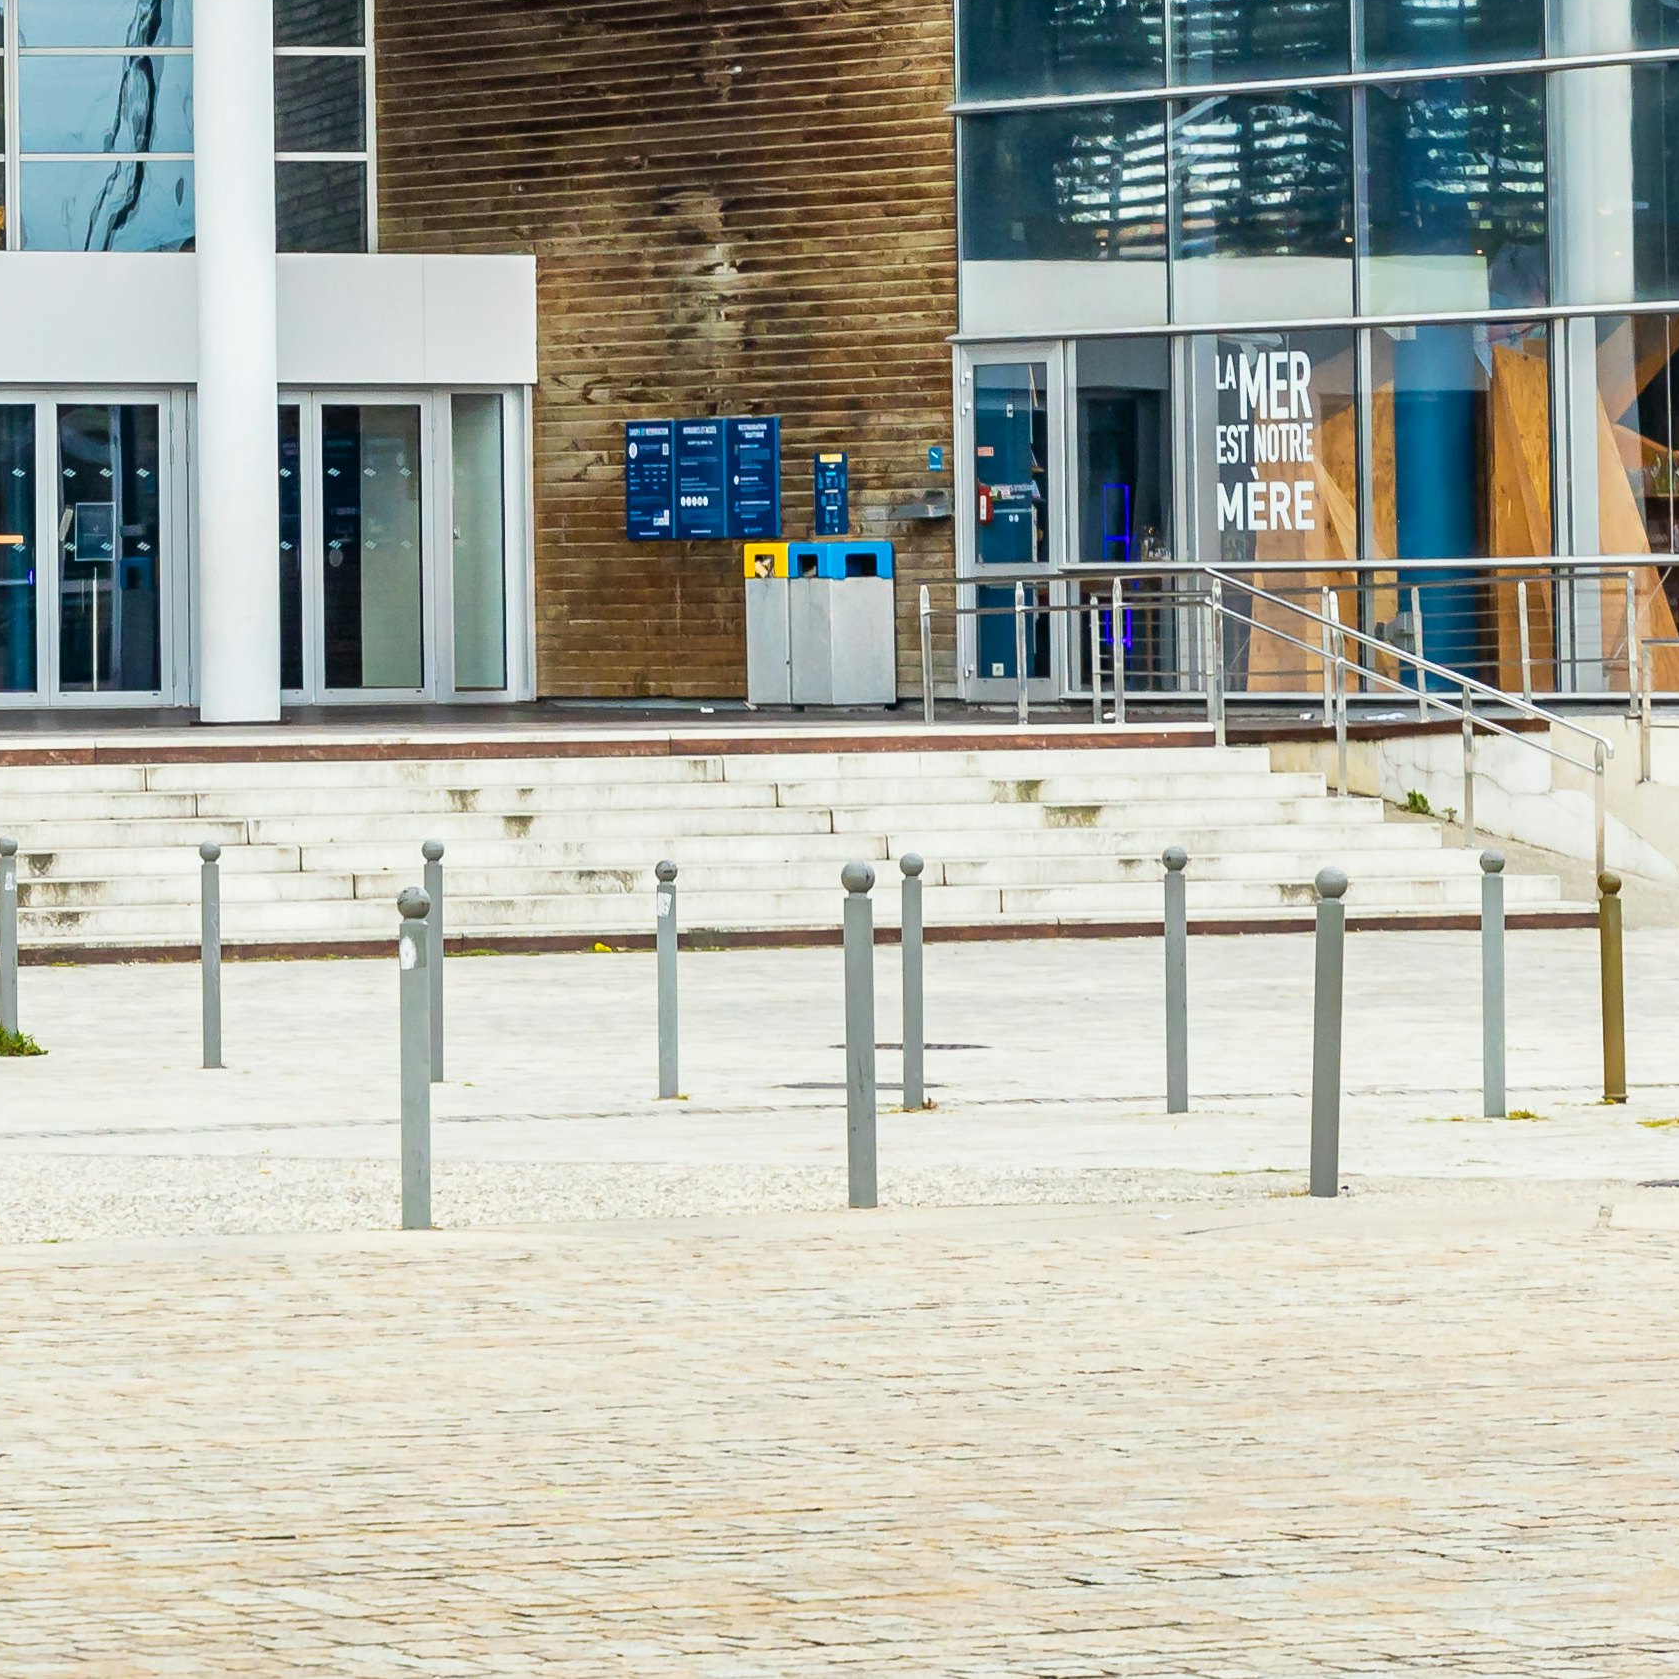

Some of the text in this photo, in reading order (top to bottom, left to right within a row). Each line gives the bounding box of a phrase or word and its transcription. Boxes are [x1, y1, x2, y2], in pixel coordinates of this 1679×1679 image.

[1215, 351, 1313, 420] LA MER
[1216, 422, 1313, 464] EST NOTRE
[1216, 466, 1315, 531] MÈRE
